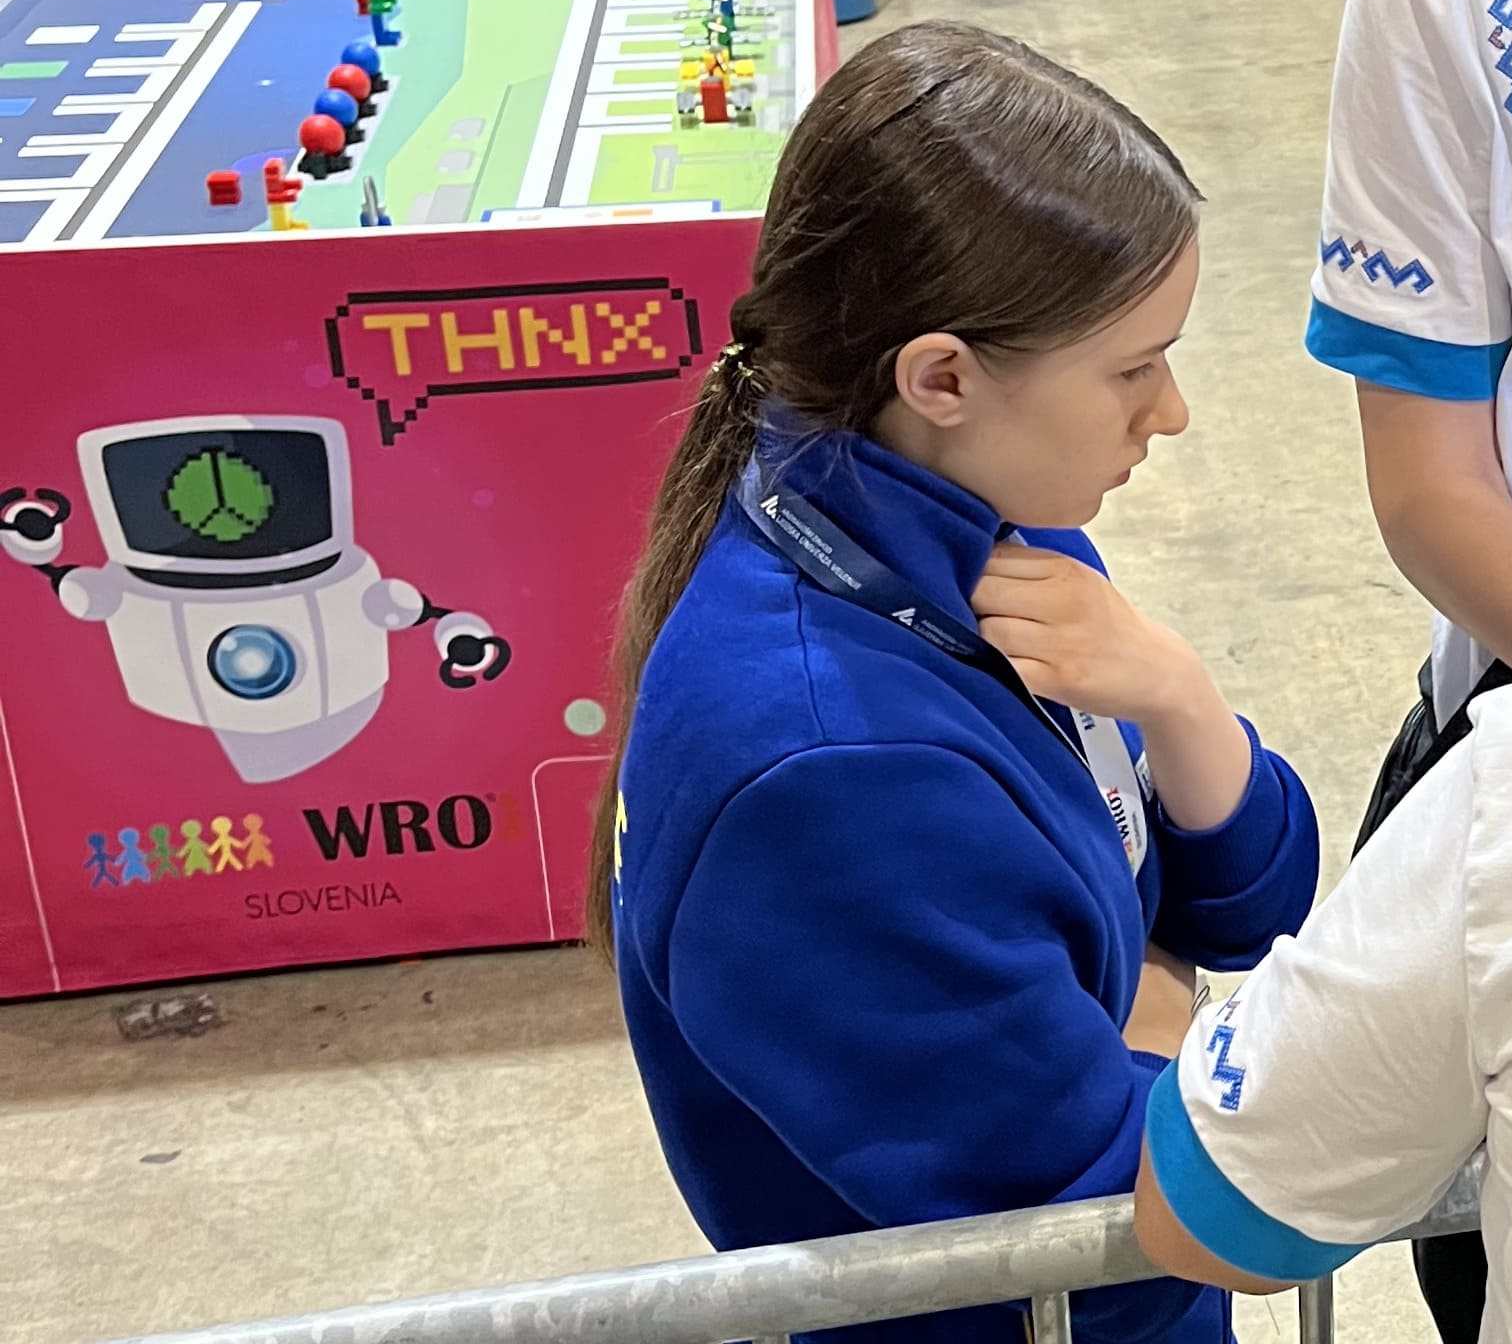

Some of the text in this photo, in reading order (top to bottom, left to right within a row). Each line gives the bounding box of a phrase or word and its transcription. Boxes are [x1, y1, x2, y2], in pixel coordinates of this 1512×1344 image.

[362, 301, 666, 375] THNX
[302, 794, 492, 861] WRO
[244, 882, 402, 919] SLOVENIA
